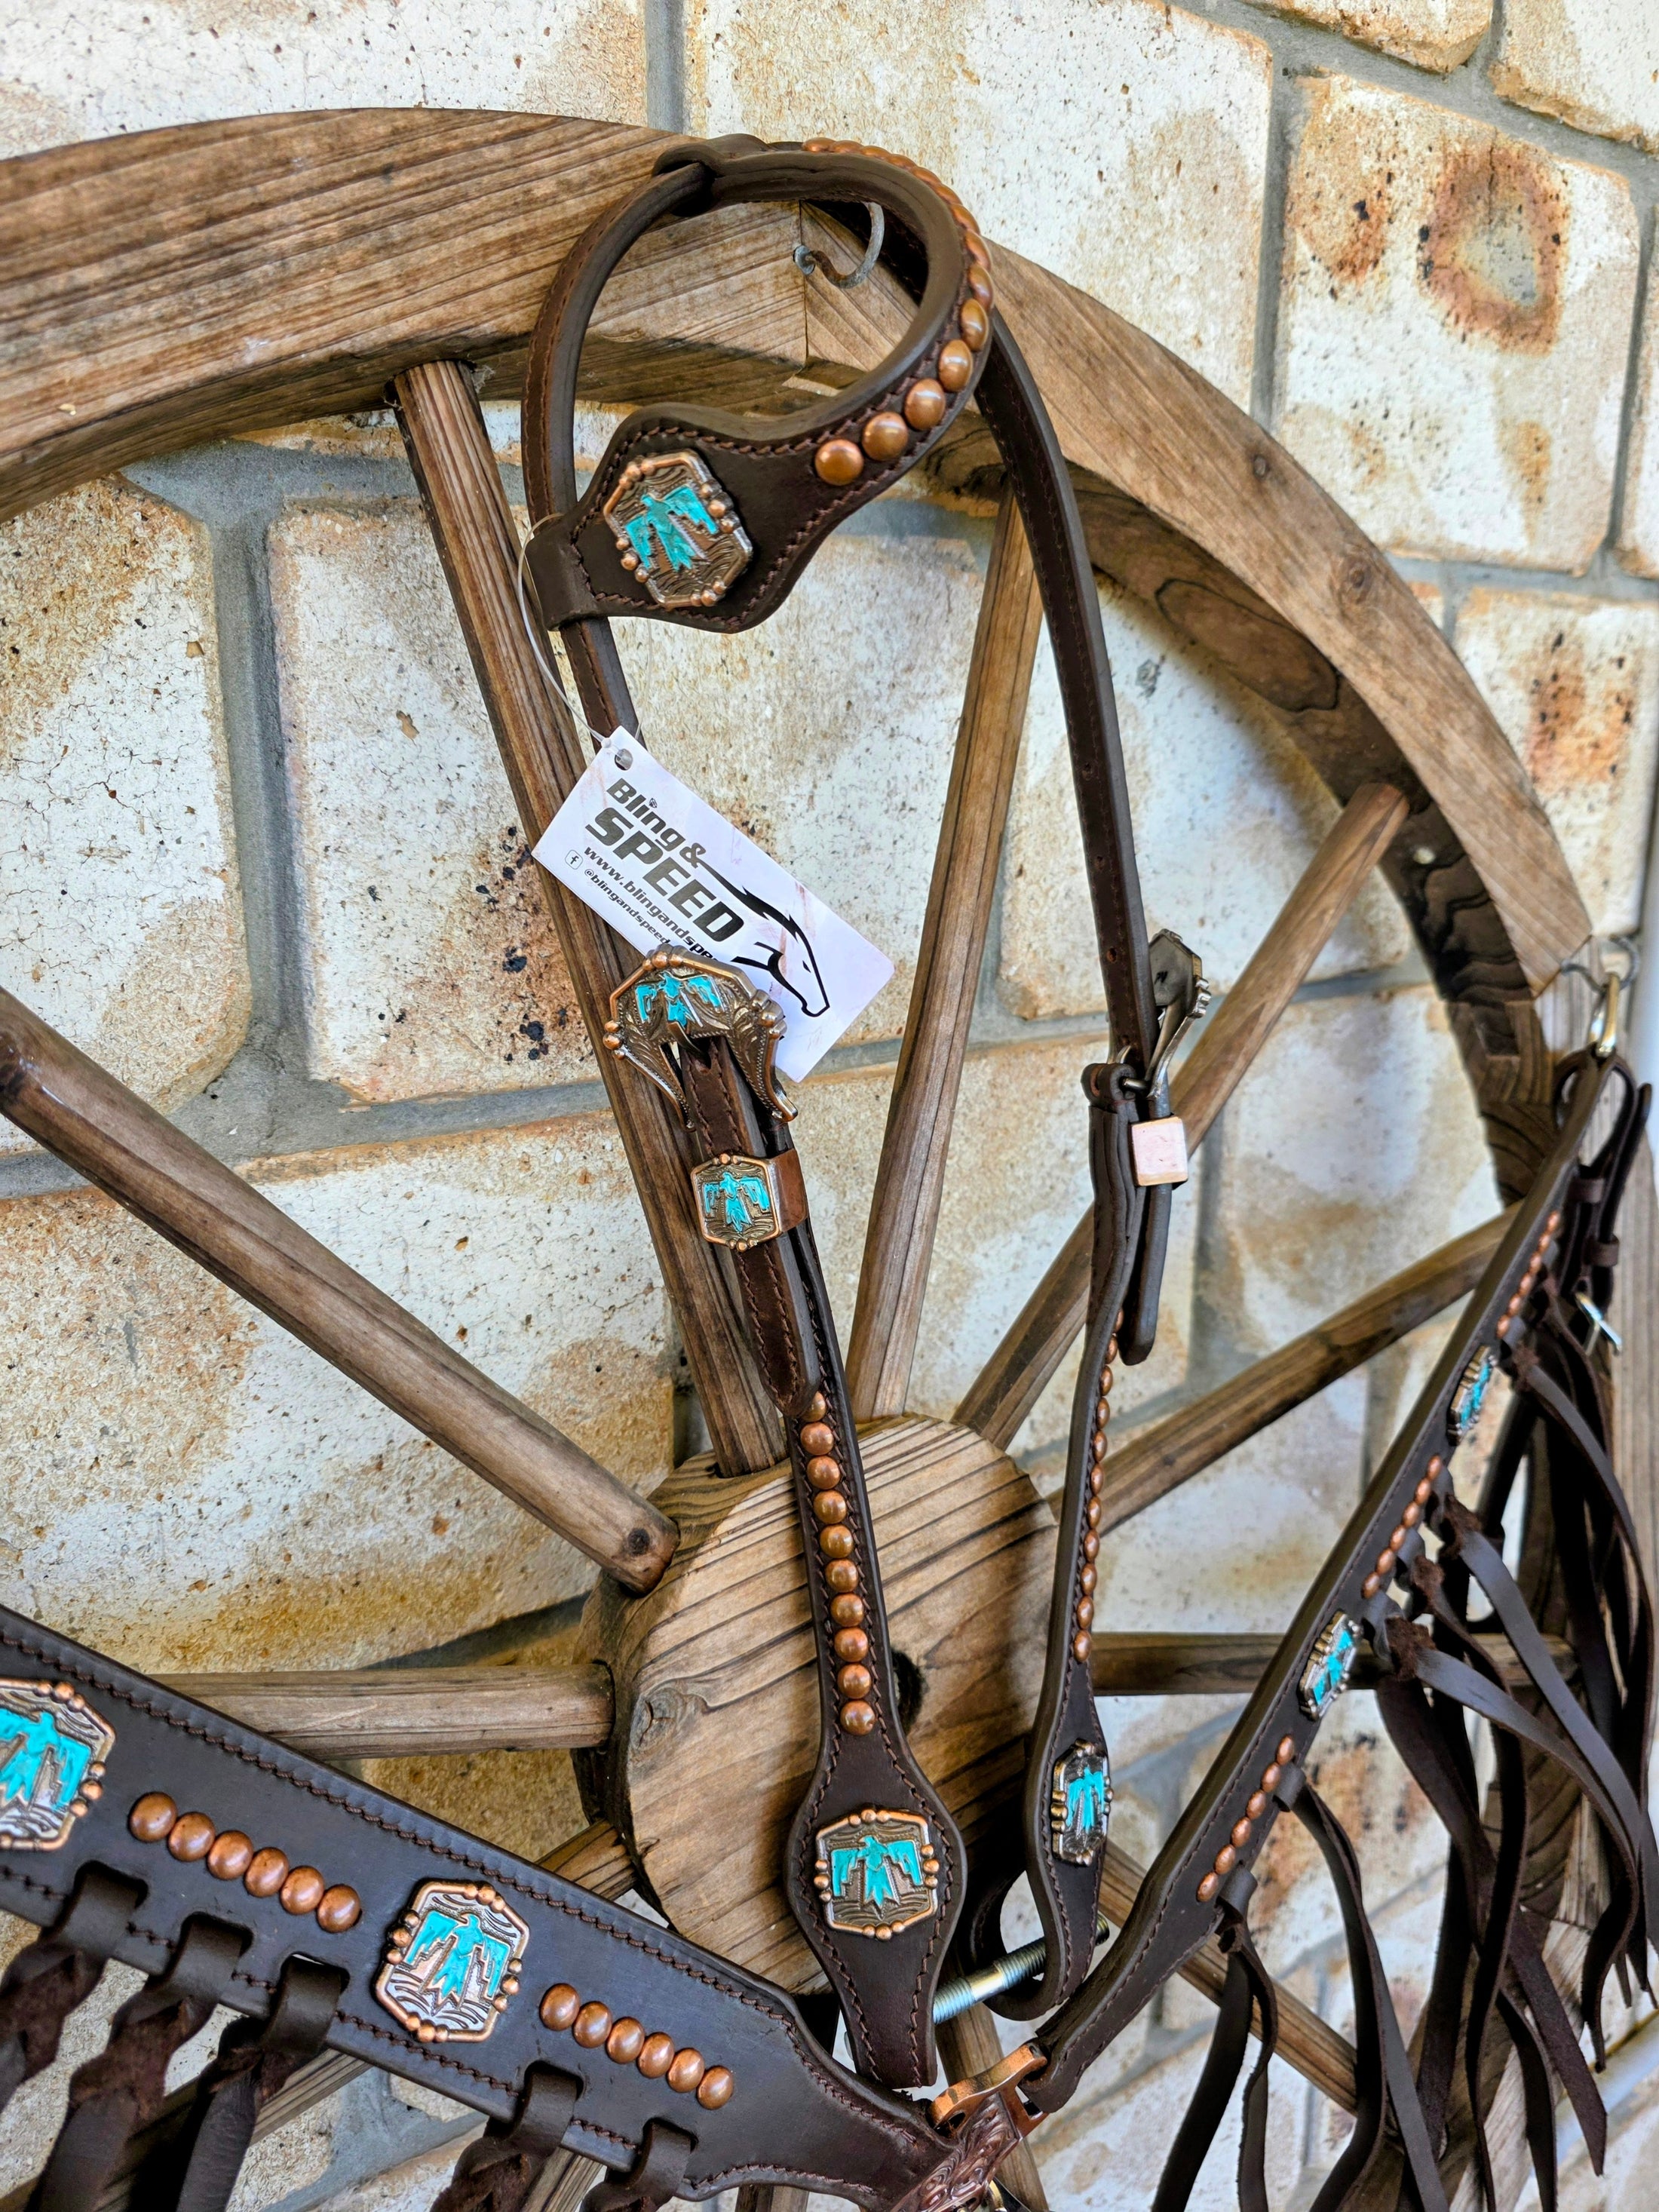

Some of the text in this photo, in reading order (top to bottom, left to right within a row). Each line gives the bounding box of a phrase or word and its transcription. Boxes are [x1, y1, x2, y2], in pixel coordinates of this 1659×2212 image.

[584, 807, 745, 943] SPEED
[606, 778, 706, 869] Bling &
[584, 845, 719, 962] www.blingandspe
